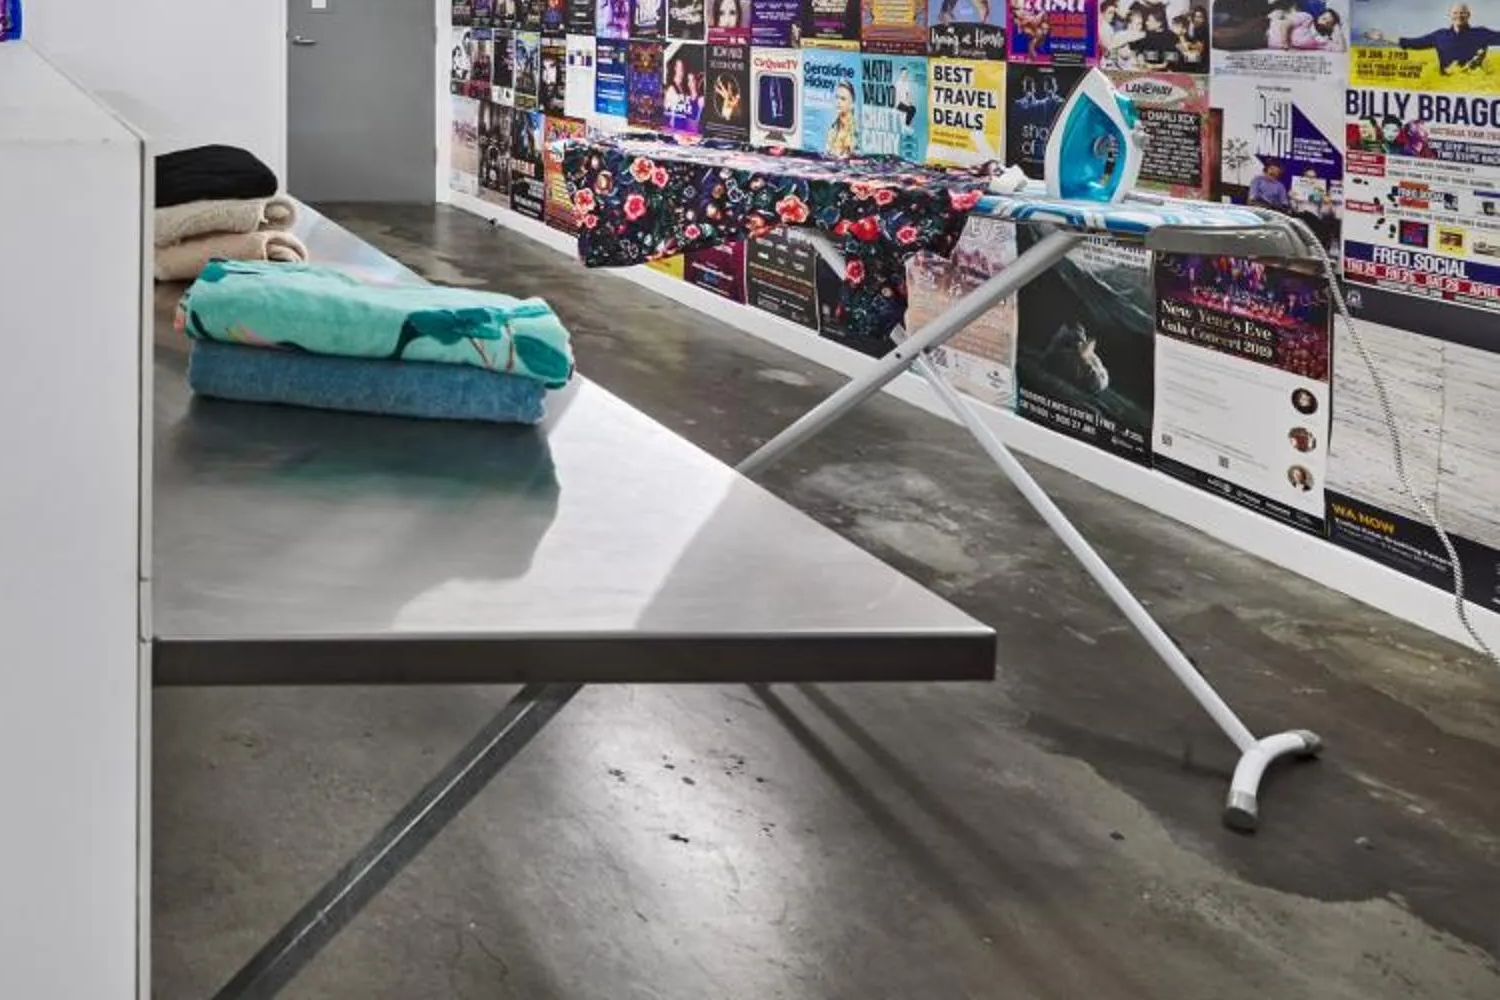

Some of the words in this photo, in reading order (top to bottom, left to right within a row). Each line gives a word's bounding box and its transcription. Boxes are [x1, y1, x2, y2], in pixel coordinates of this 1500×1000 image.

[803, 61, 856, 79] Geraldine
[863, 59, 893, 83] NATH
[933, 65, 973, 85] BEST
[933, 86, 997, 109] TRAVEL
[1345, 89, 1411, 120] BILLY
[933, 107, 984, 131] DEALS
[1161, 299, 1192, 320] New
[1199, 309, 1242, 333] Year's
[1244, 322, 1272, 341] Eve
[1161, 317, 1188, 337] Gala
[1190, 326, 1241, 351] Concert
[1243, 340, 1273, 359] 2019
[1332, 503, 1356, 521] WA
[1358, 512, 1396, 534] NOW
